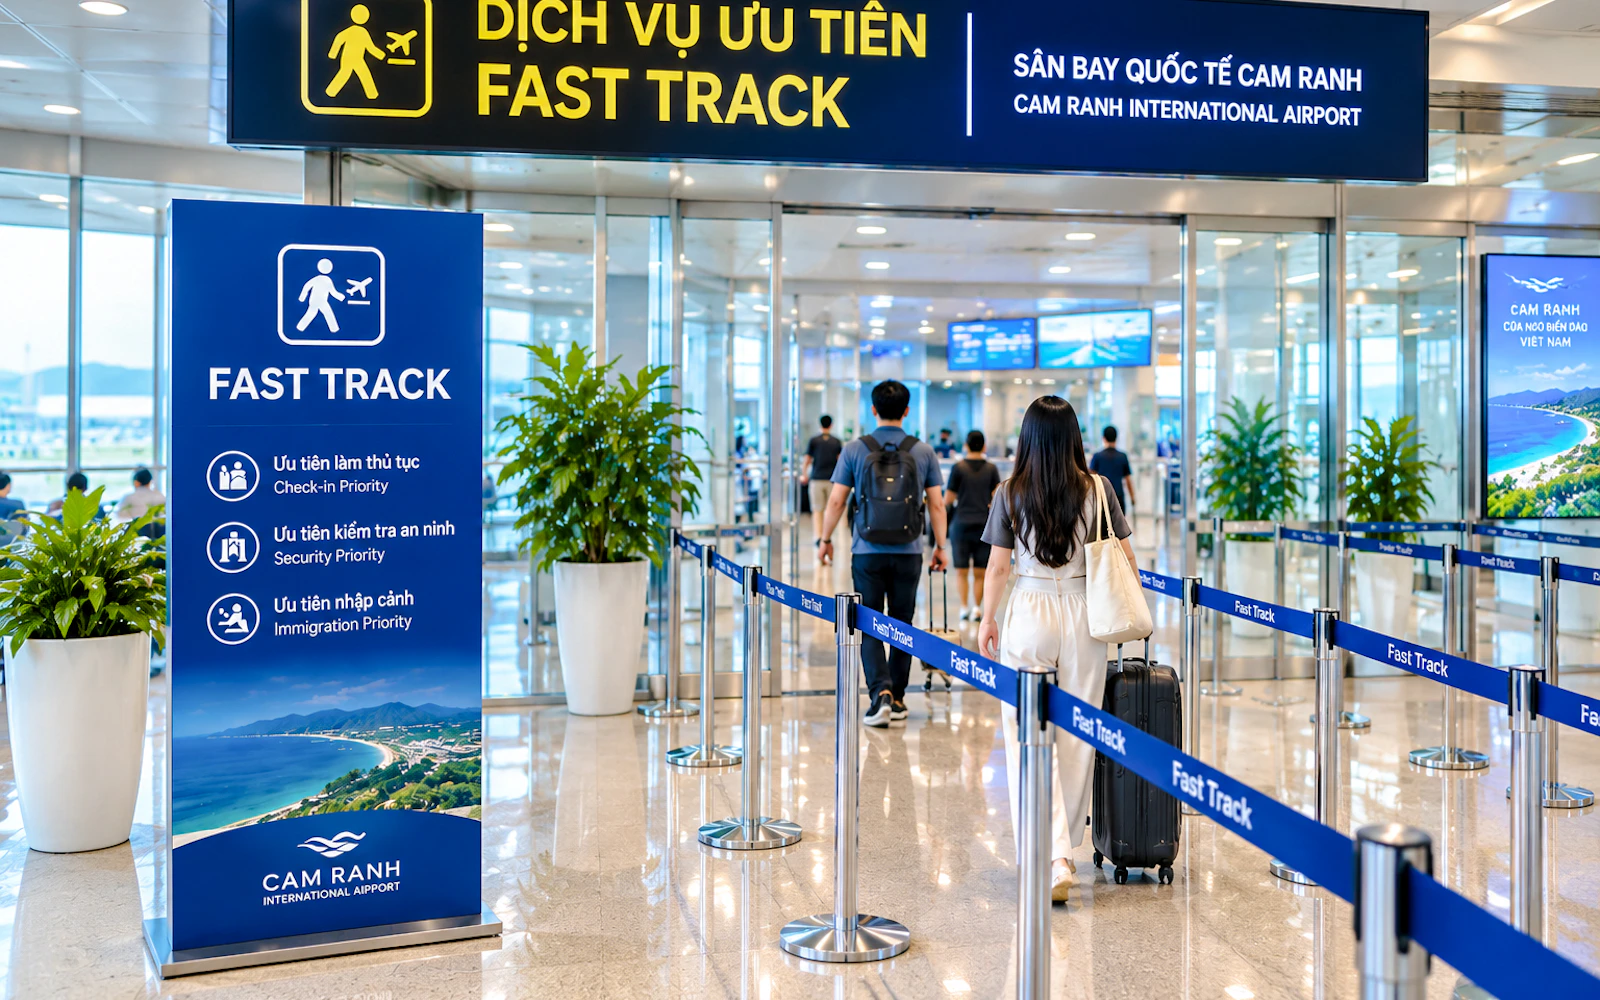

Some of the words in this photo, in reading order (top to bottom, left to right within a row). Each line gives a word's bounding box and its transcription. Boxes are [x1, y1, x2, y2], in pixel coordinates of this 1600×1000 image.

[479, 0, 606, 52] DỊCH
[625, 2, 699, 58] VỤ
[720, 1, 793, 52] ƯU
[810, 0, 926, 57] TIÊN
[1014, 48, 1064, 78] SÂN
[1073, 56, 1119, 80] BAY
[1126, 52, 1197, 84] QUỐC
[1204, 54, 1232, 85] TẾ
[1238, 64, 1290, 88] CAM
[1299, 66, 1361, 91] RANH
[479, 63, 629, 119] FAST
[647, 70, 850, 127] TRACK
[1014, 94, 1060, 114] CAM
[1068, 96, 1122, 116] RANH
[1130, 99, 1278, 122] INTERNATIONAL
[1283, 105, 1361, 126] AIRPORT
[1511, 304, 1538, 315] CAM
[1544, 304, 1579, 315] RANH
[1548, 337, 1570, 347] NAM
[210, 367, 309, 400] FAST
[320, 368, 451, 399] TRACK
[274, 455, 296, 471] Ưu
[300, 455, 329, 470] tiên
[335, 455, 361, 470] làm
[366, 453, 391, 469] thủ
[396, 456, 419, 472] tục
[275, 480, 335, 494] Check-in
[340, 479, 388, 494] Priority
[275, 526, 296, 542] Ưu
[300, 525, 329, 541] tiên
[335, 521, 370, 539] kiểm
[375, 524, 396, 538] tra
[401, 526, 418, 537] an
[424, 521, 454, 536] ninh
[275, 550, 332, 566] Security
[336, 548, 385, 563] Priority
[275, 597, 296, 613] Ưu
[301, 595, 330, 611] tiên
[336, 593, 373, 612] nhập
[378, 590, 413, 606] cảnh
[1235, 601, 1254, 616] Fast
[1253, 604, 1275, 623] Track
[275, 619, 358, 637] Immigration
[363, 615, 412, 630] Priority
[951, 650, 969, 675] Fast
[971, 661, 997, 689] Track
[1388, 643, 1412, 666] Fast
[1414, 652, 1448, 678] Track
[1581, 703, 1600, 727] Fa
[1096, 719, 1126, 755] Track
[1172, 760, 1206, 804] Fast
[1206, 779, 1252, 830] Track
[263, 869, 321, 892] CAM
[332, 860, 400, 884] RANH
[263, 888, 351, 906] INTERNATIONAL
